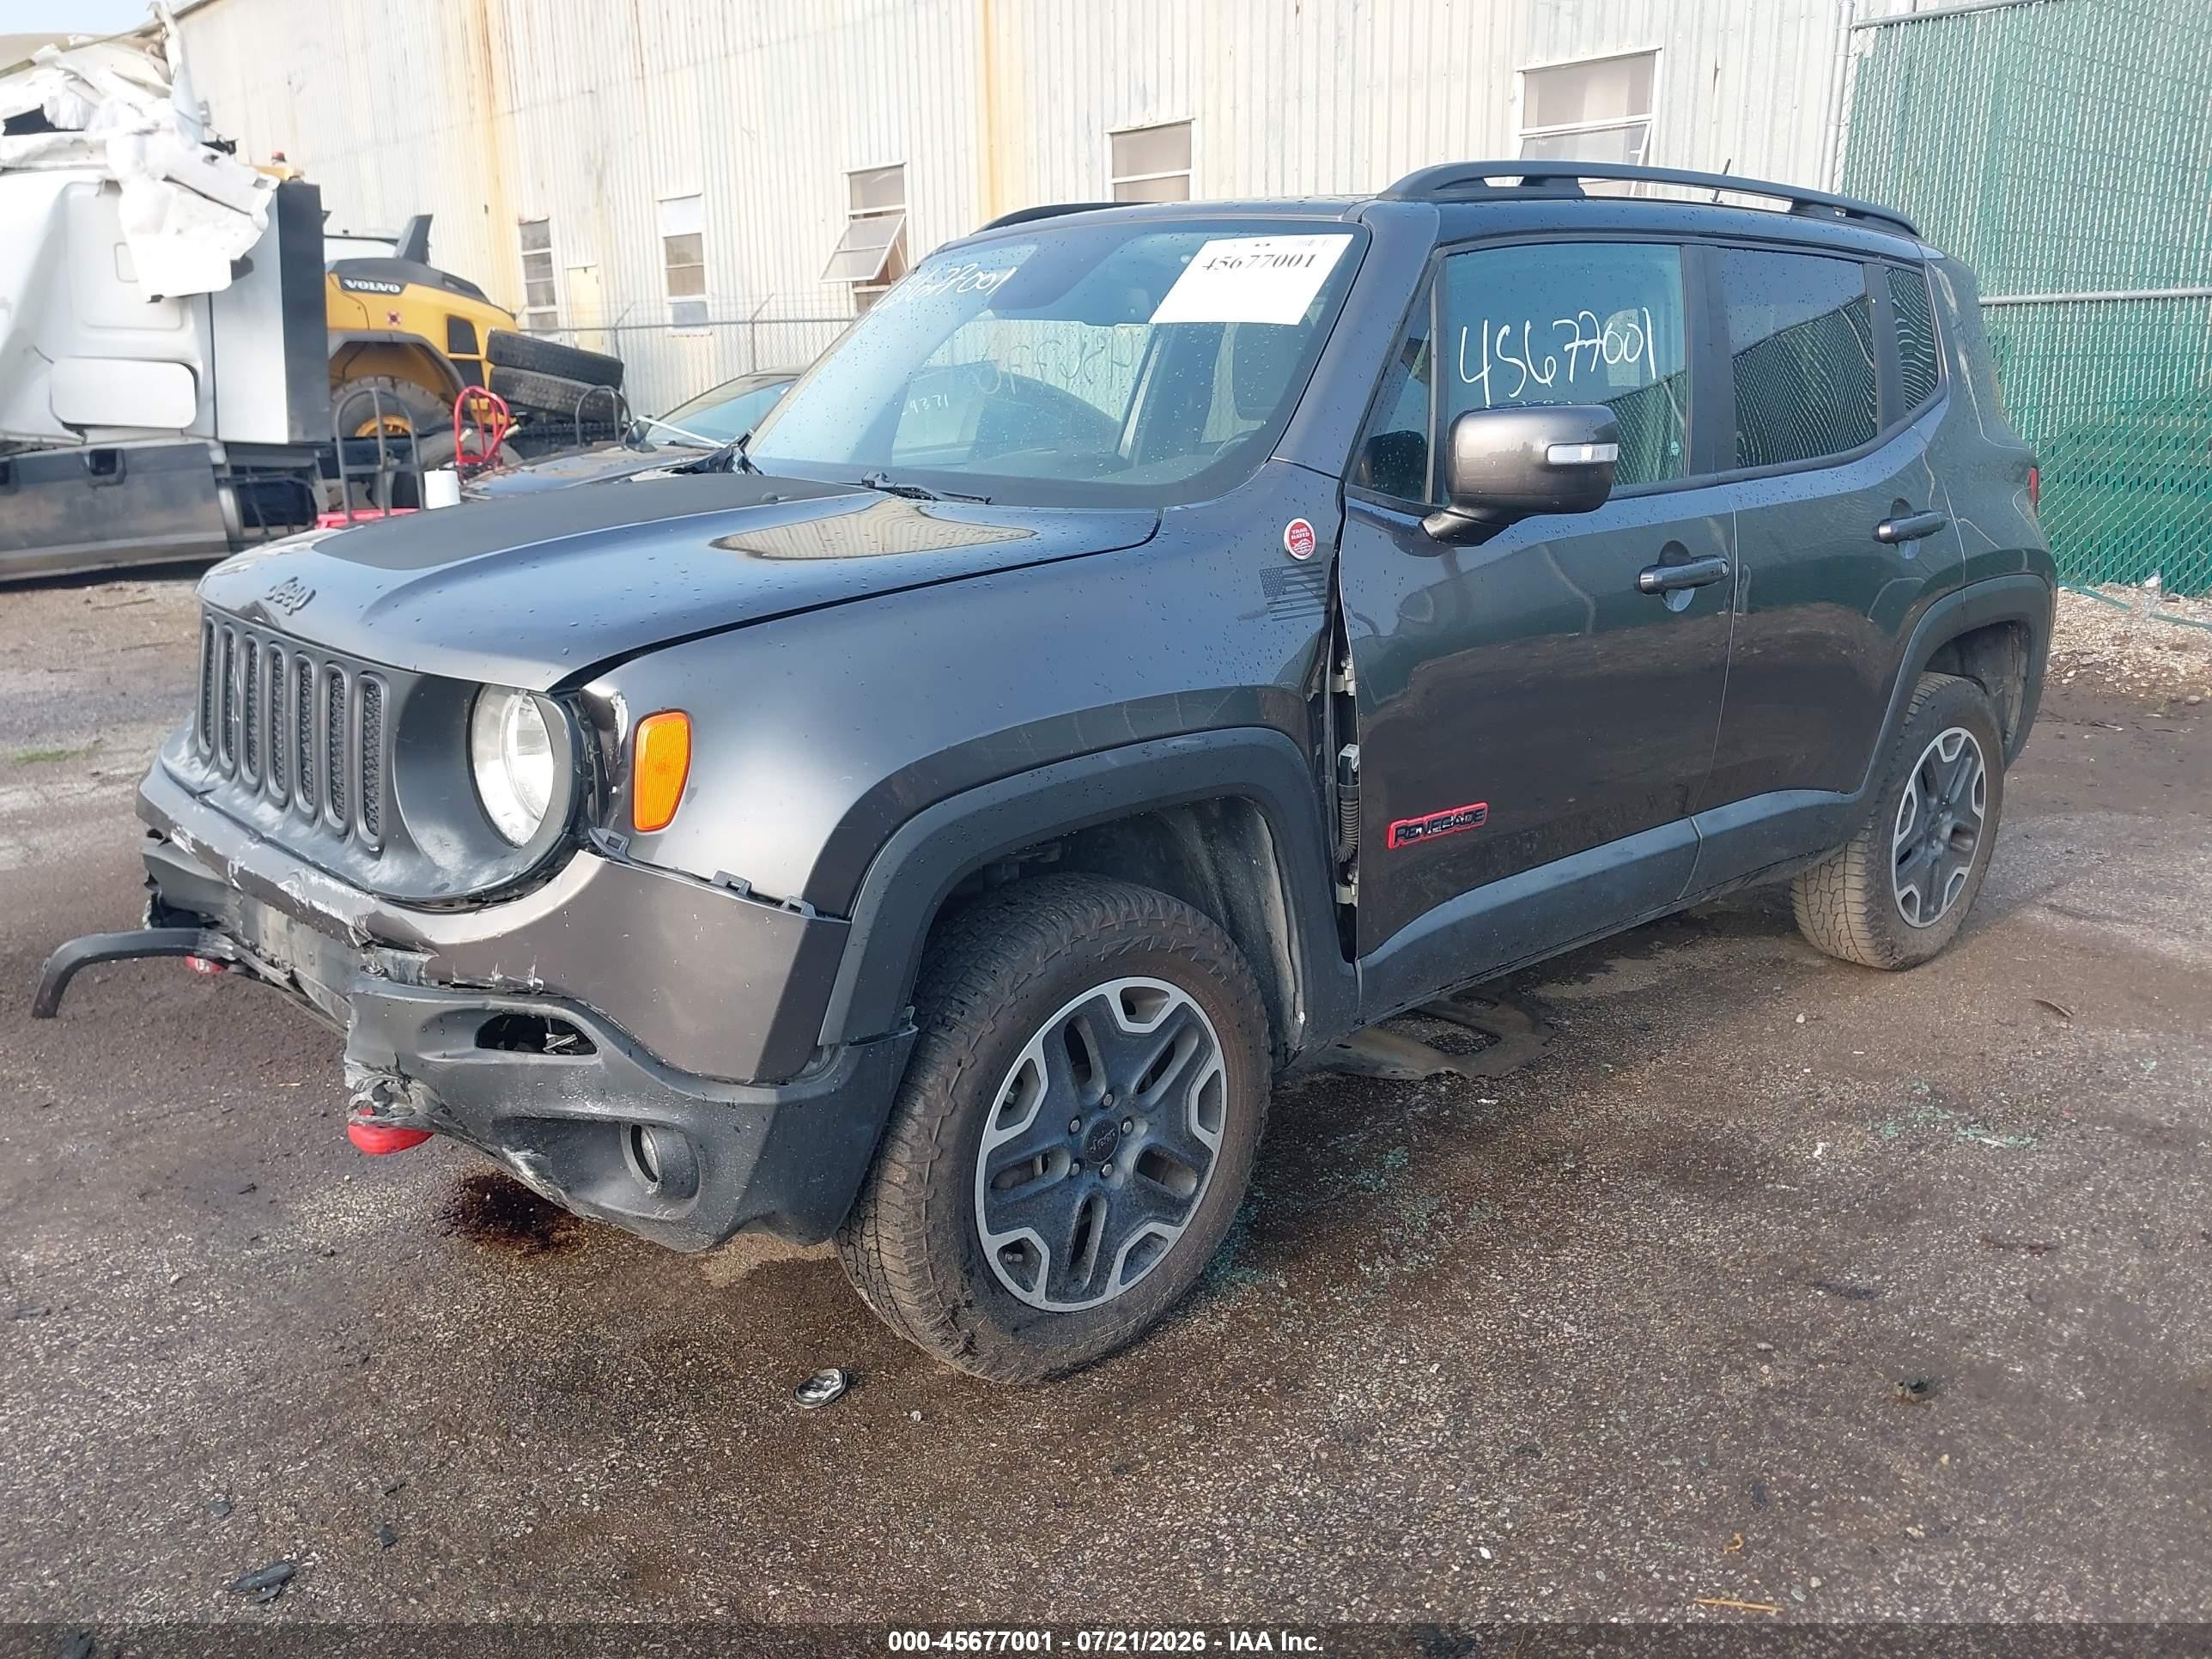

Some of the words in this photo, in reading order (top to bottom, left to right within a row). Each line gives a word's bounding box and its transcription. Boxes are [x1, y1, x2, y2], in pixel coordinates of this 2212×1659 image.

[1202, 253, 1317, 270] 45677001
[343, 279, 401, 293] VOLVO
[1460, 307, 1656, 408] 45677001
[1291, 532, 1310, 540] RATED
[264, 576, 317, 616] Jeep
